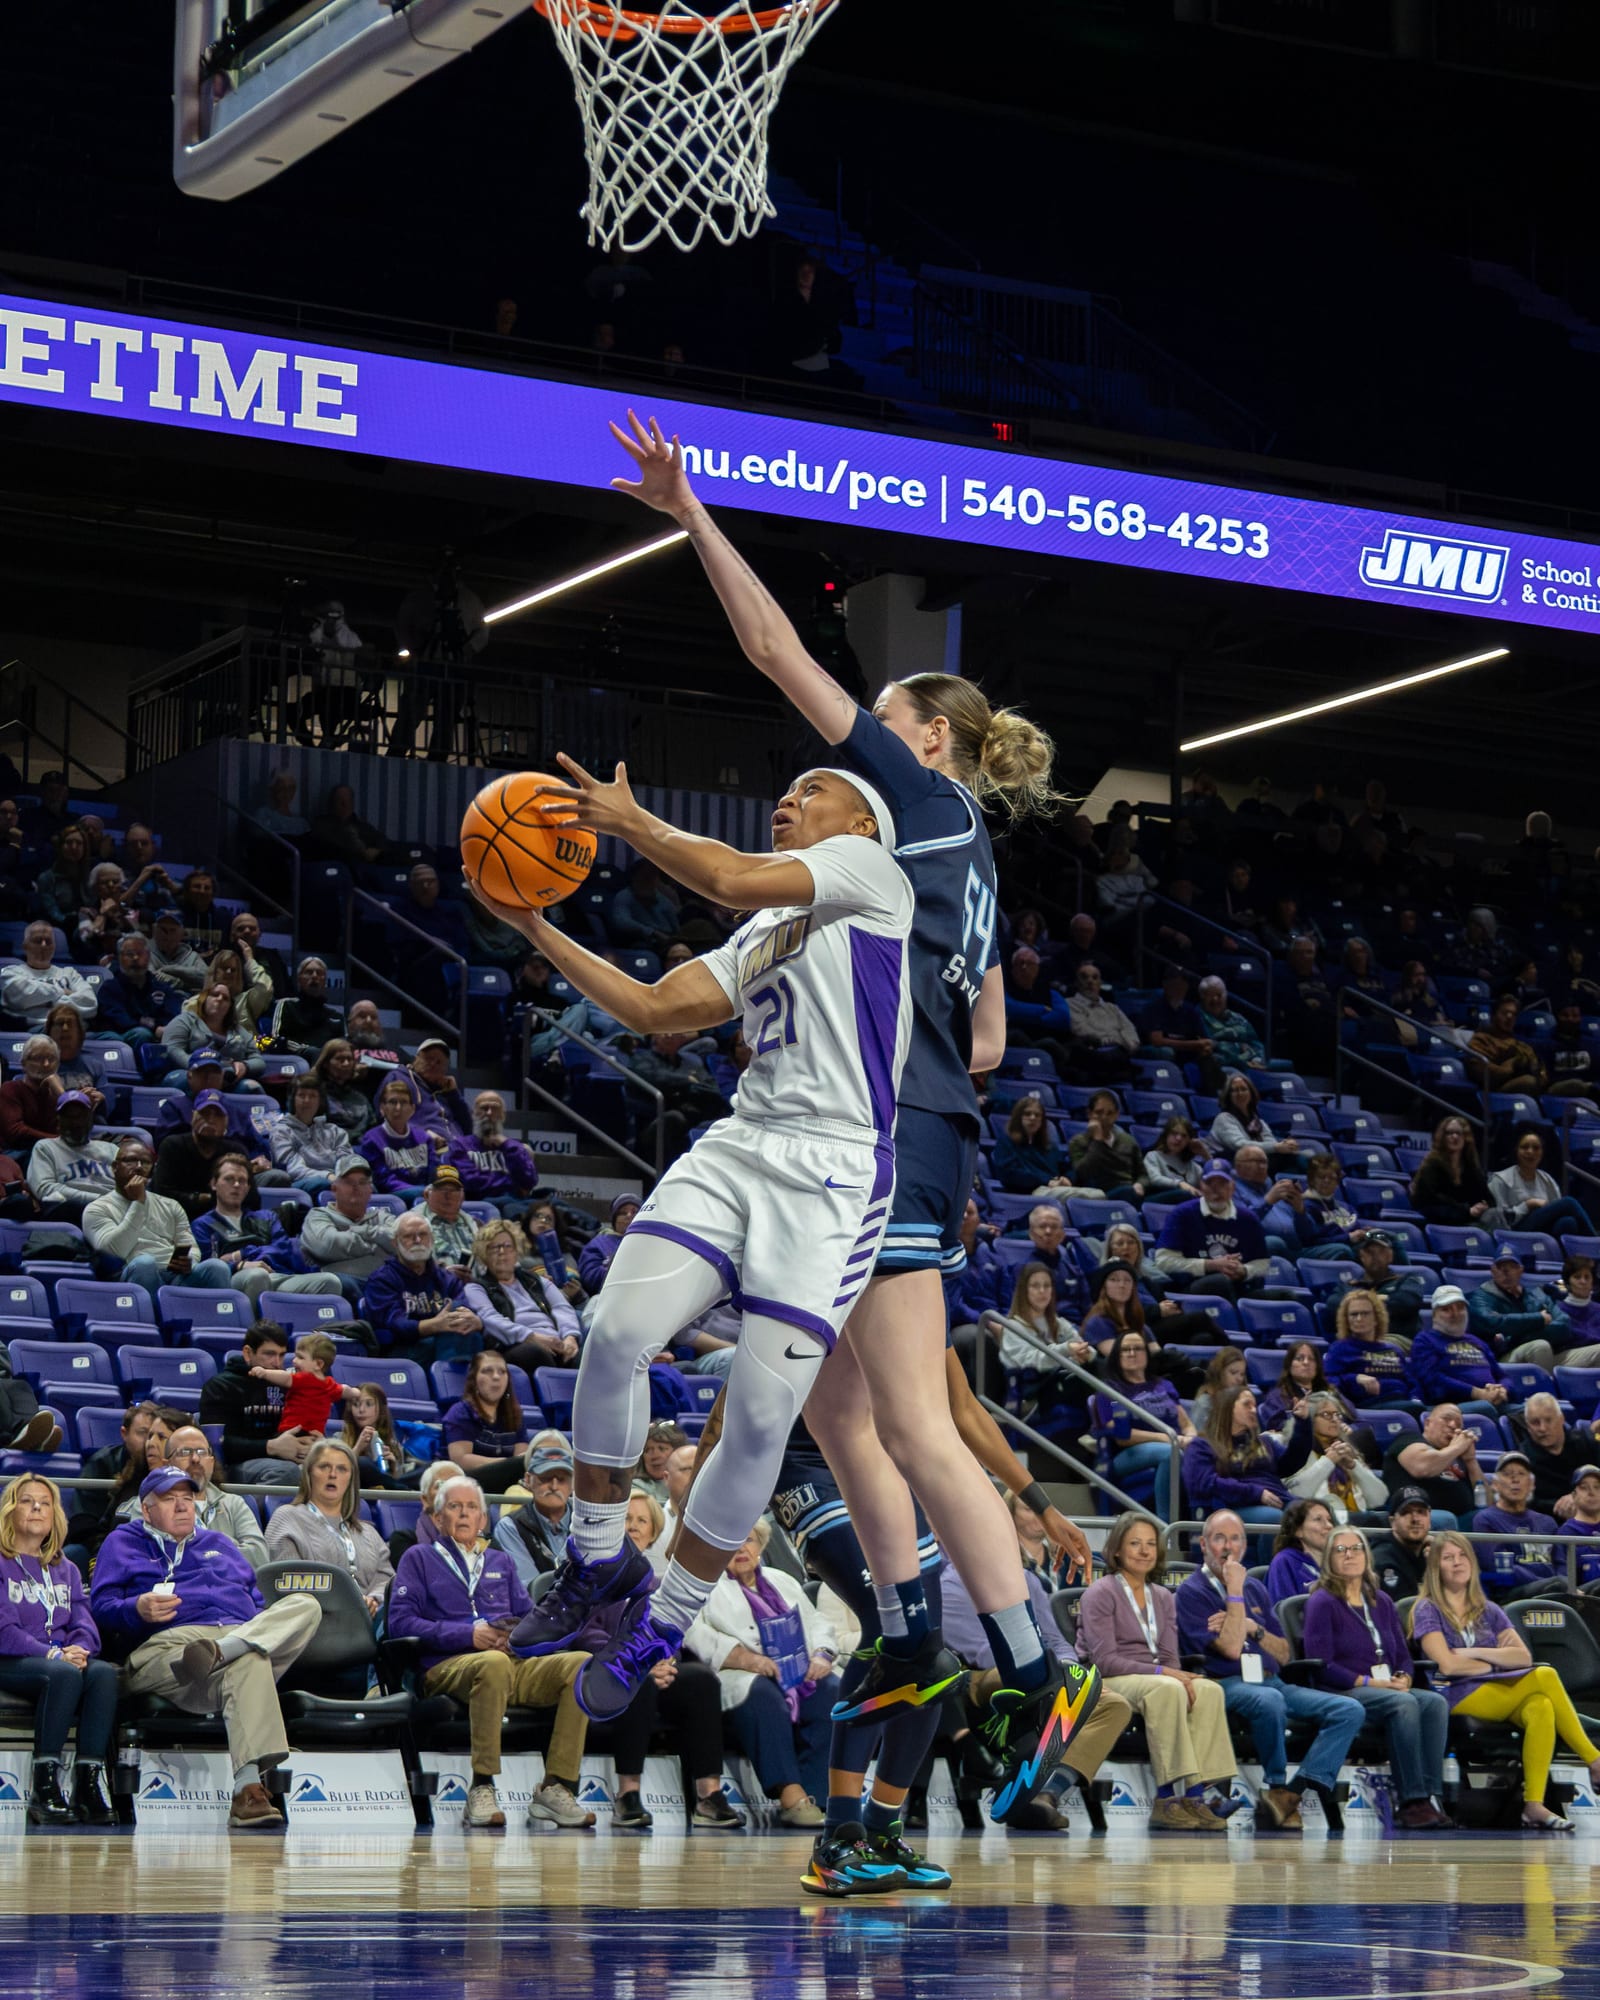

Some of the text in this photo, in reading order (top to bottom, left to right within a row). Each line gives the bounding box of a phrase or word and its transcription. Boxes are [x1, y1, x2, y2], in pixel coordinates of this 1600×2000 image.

[0, 308, 358, 437] ETIME
[650, 431, 1270, 559] mu.edu/pce 540-568-4253
[1364, 536, 1504, 598] JMU
[1522, 558, 1592, 587] School
[1521, 583, 1600, 613] & Conti
[962, 861, 997, 976] 54
[749, 974, 800, 1057] 21
[552, 1187, 594, 1200] merica
[781, 1485, 817, 1527] ODU
[276, 1573, 332, 1591] JMU
[1523, 1610, 1564, 1626] JMU
[180, 1790, 212, 1801] BLUE
[329, 1790, 407, 1802] BLUE RIDGE
[508, 1791, 532, 1801] RID
